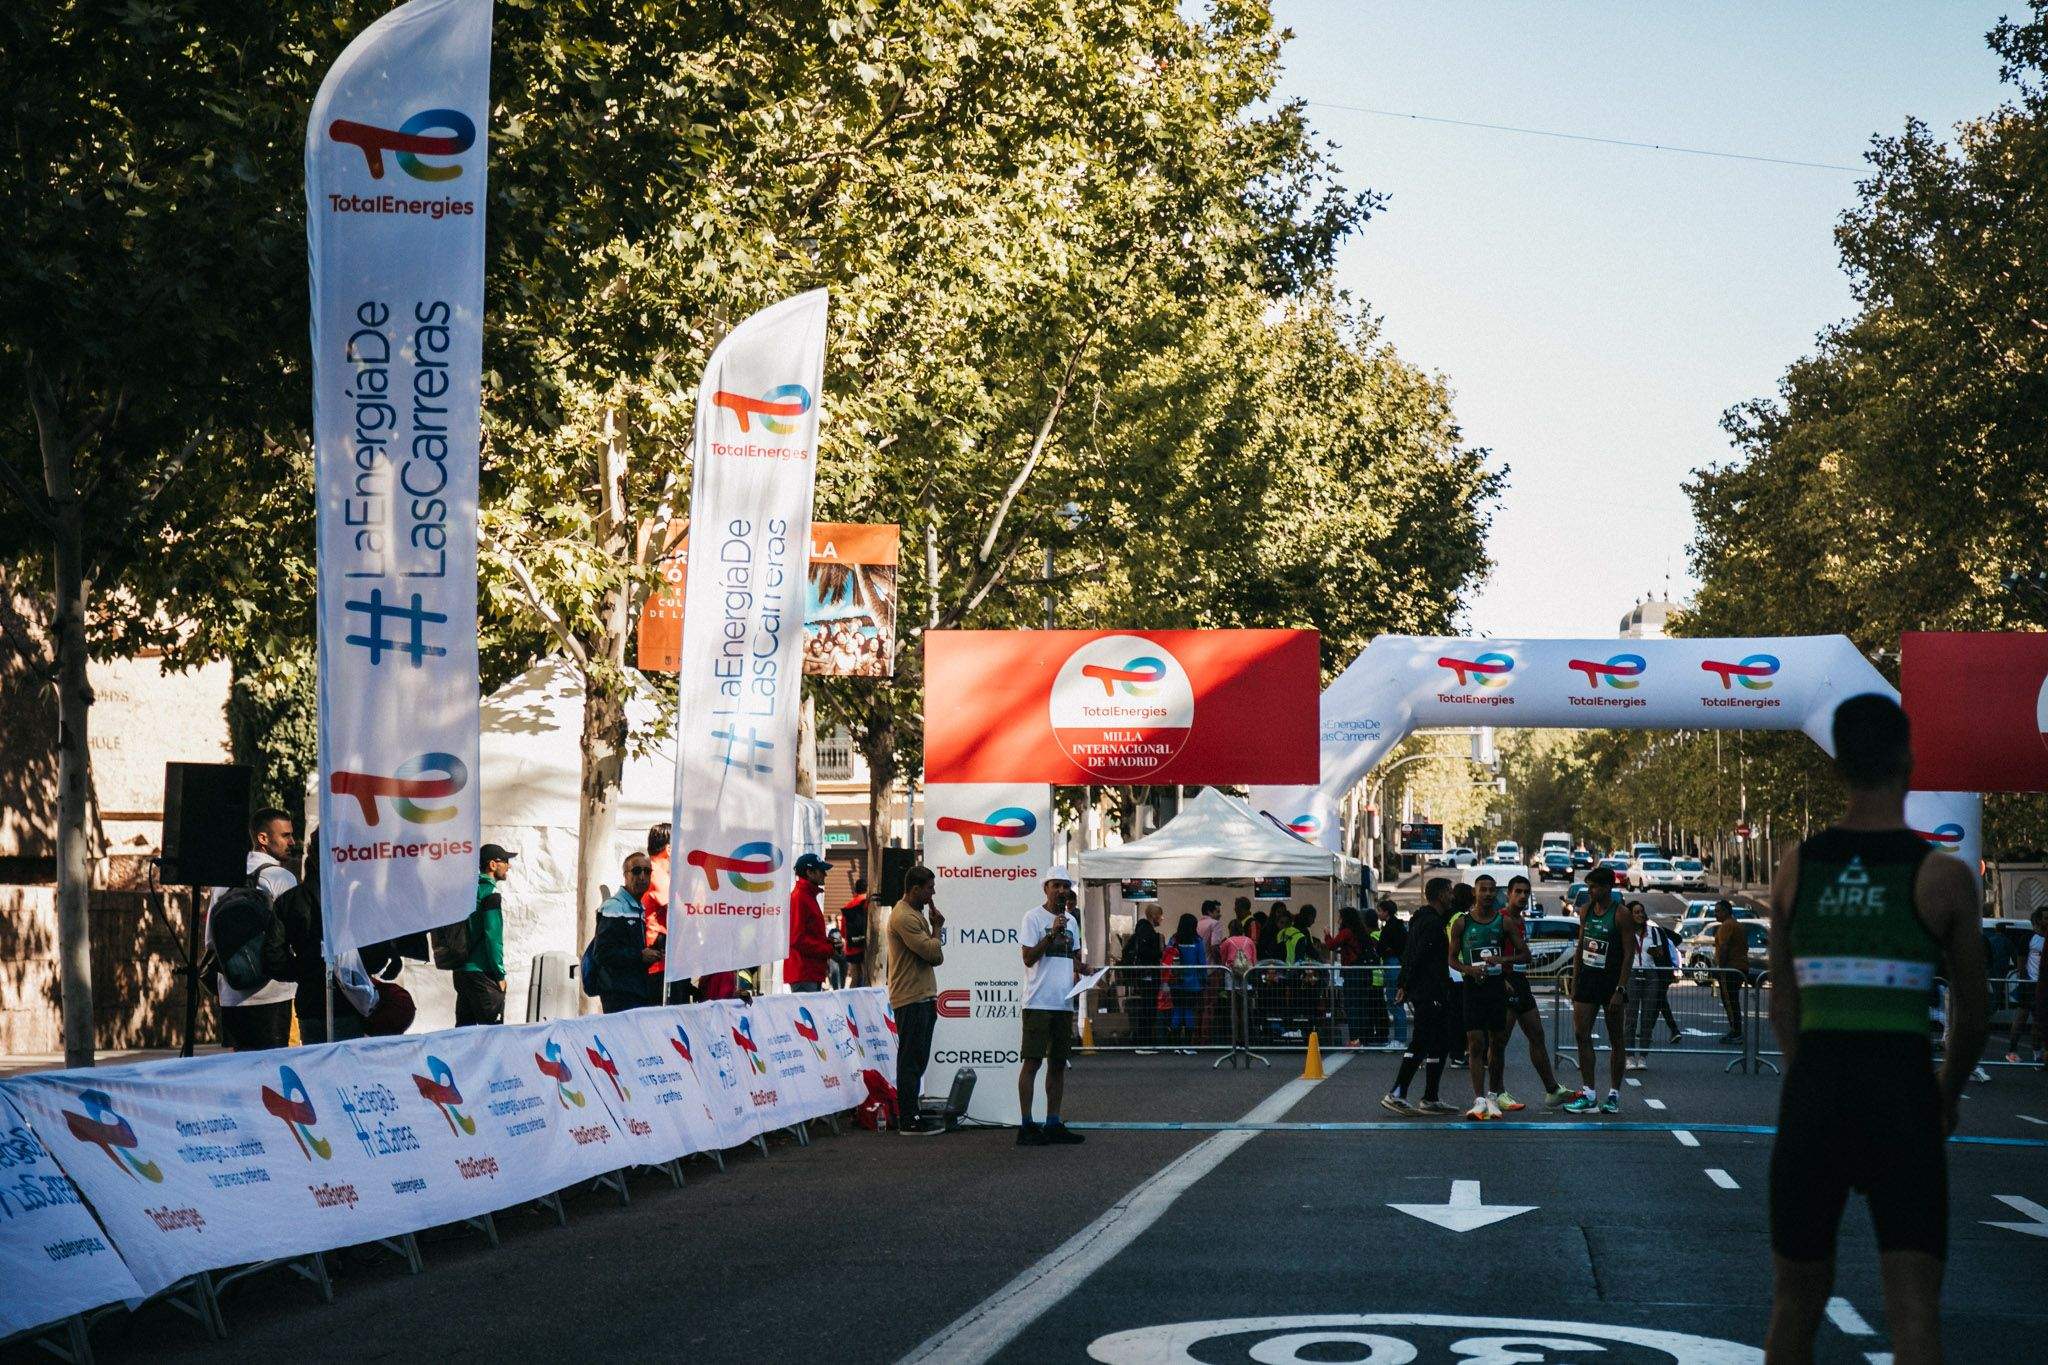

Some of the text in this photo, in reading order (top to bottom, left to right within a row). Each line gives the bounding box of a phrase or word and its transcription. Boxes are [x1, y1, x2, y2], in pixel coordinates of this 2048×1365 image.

[329, 194, 474, 220] TotalEnergies
[400, 300, 451, 578] LasCarreras
[1437, 693, 1515, 707] TotalEnergies
[1568, 695, 1647, 708] TotalEnergies
[1700, 696, 1781, 709] TotalEnergies
[1082, 705, 1168, 719] TotalEnergies
[1103, 731, 1143, 742] MILLA
[1088, 756, 1158, 767] DE MADRID
[332, 838, 473, 863] TotalEnergies
[937, 866, 1037, 881] TotalEnergies
[990, 979, 1018, 987] balance
